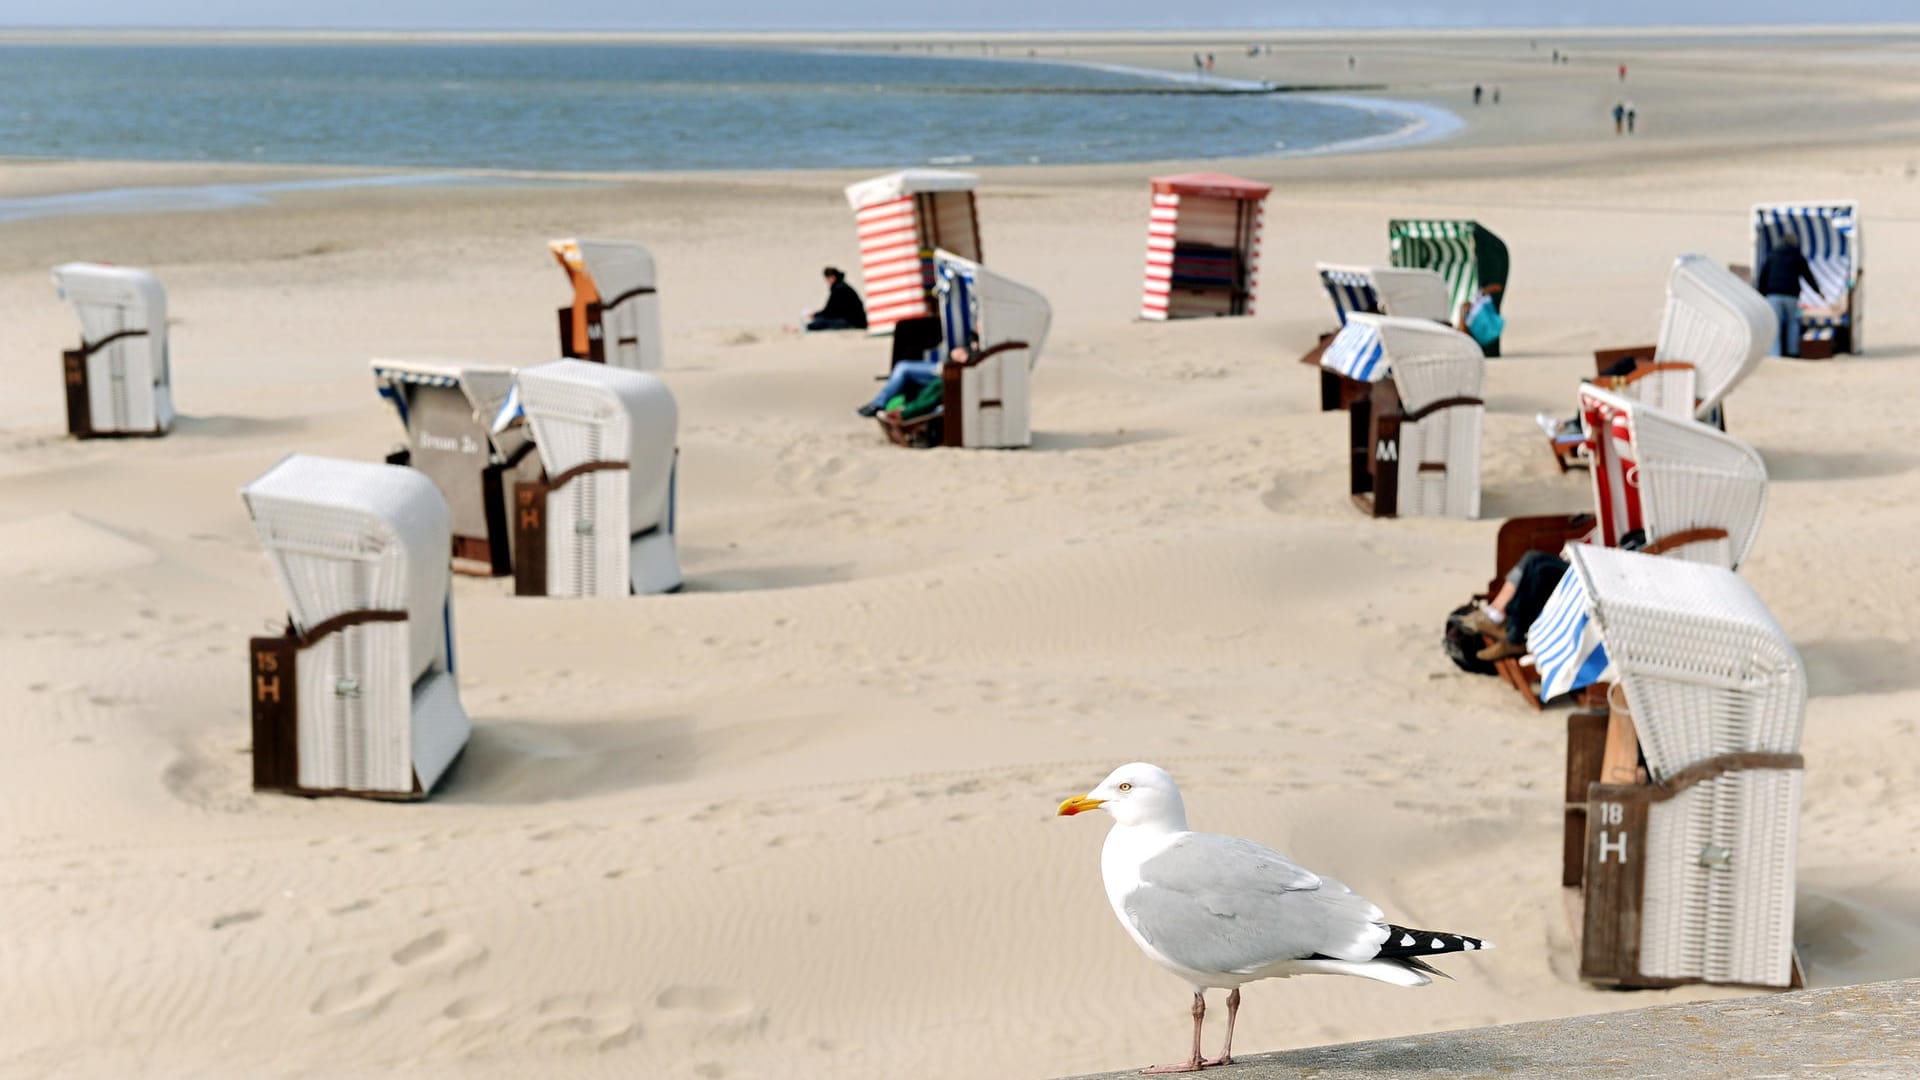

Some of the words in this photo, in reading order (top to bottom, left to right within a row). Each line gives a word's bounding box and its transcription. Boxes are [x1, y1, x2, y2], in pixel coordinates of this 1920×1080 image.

[1375, 439, 1397, 461] M
[520, 509, 539, 529] H
[257, 651, 277, 671] 15
[257, 675, 280, 702] H
[1600, 801, 1623, 825] 18
[1600, 831, 1627, 864] H
